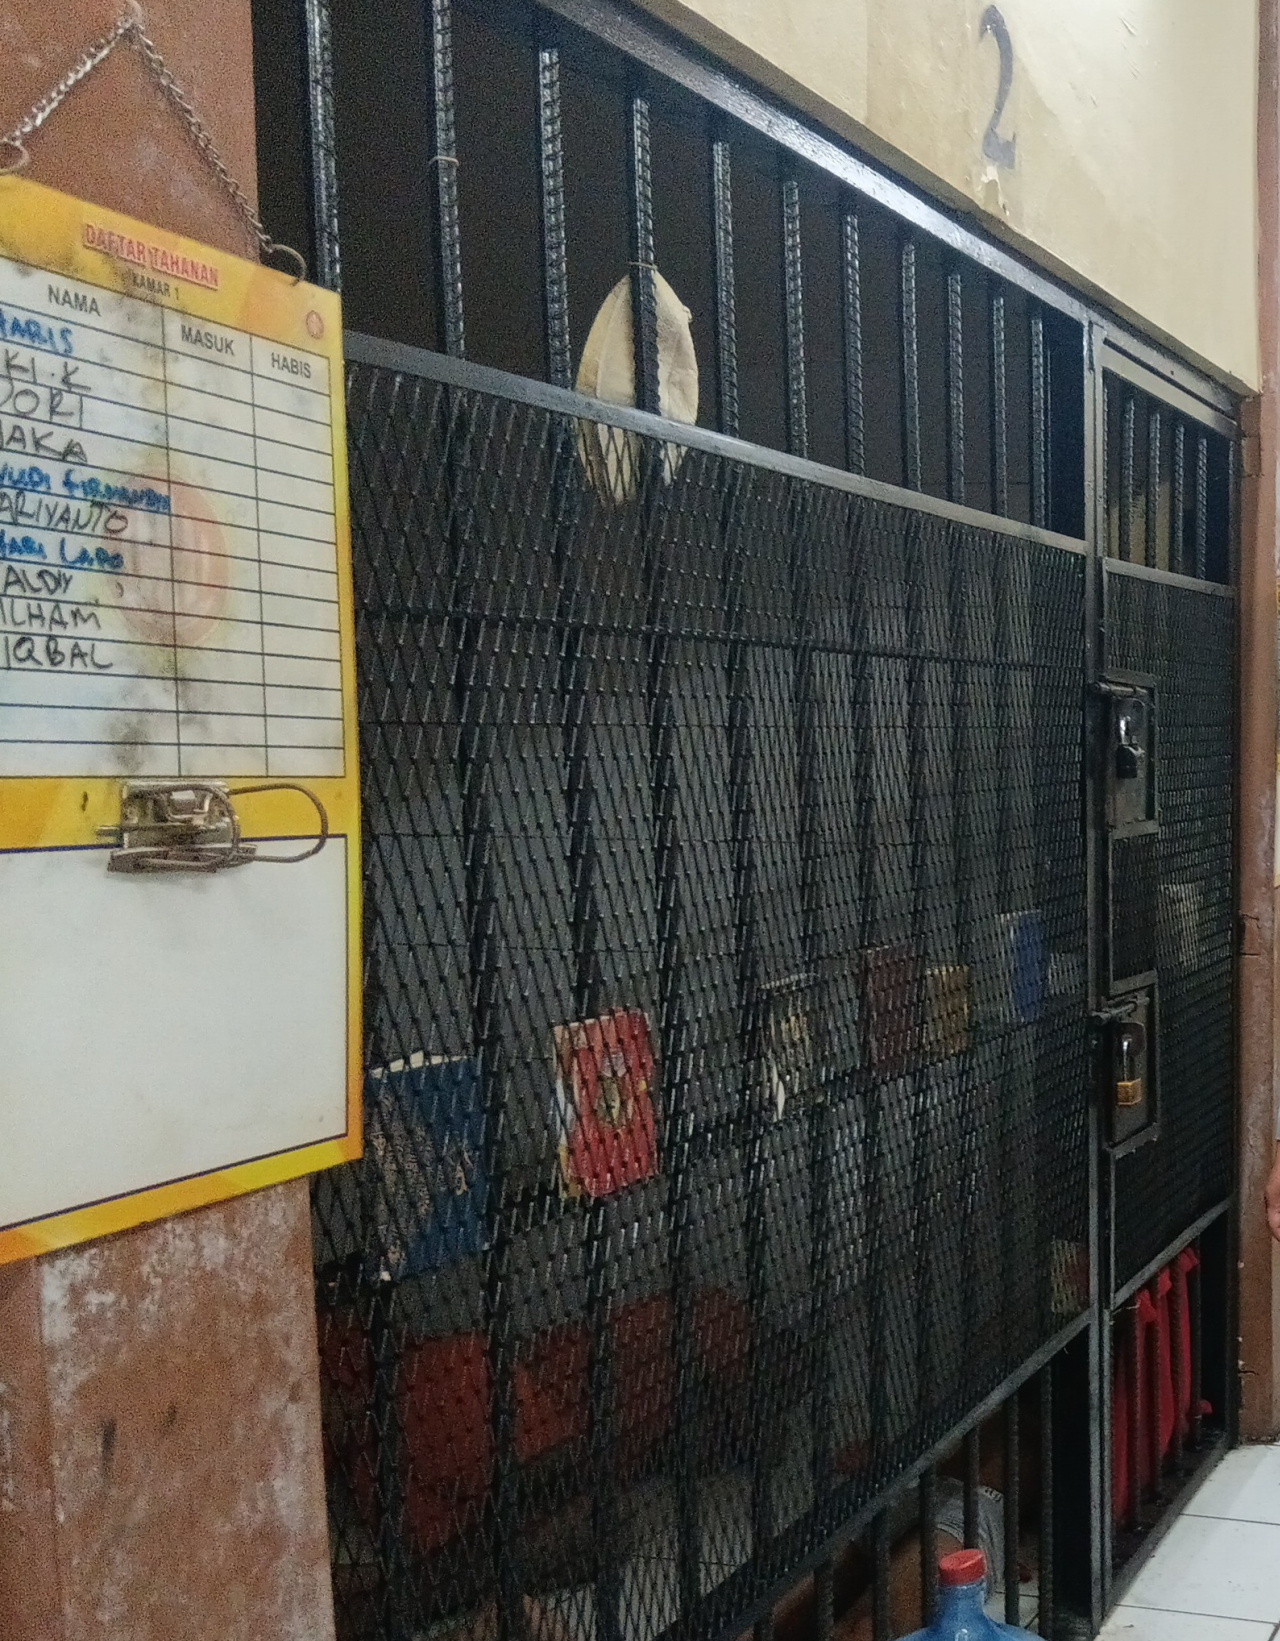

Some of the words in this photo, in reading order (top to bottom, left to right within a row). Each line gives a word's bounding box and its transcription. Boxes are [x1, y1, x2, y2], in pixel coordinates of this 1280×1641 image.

[980, 4, 1016, 170] 2
[85, 223, 146, 263] DAFTAR
[150, 246, 219, 287] TAHANAN
[48, 284, 102, 317] NAMA
[180, 324, 235, 356] MASUK
[270, 352, 312, 379] HABIS
[0, 420, 89, 463] AKA
[4, 634, 113, 671] IQBAL
